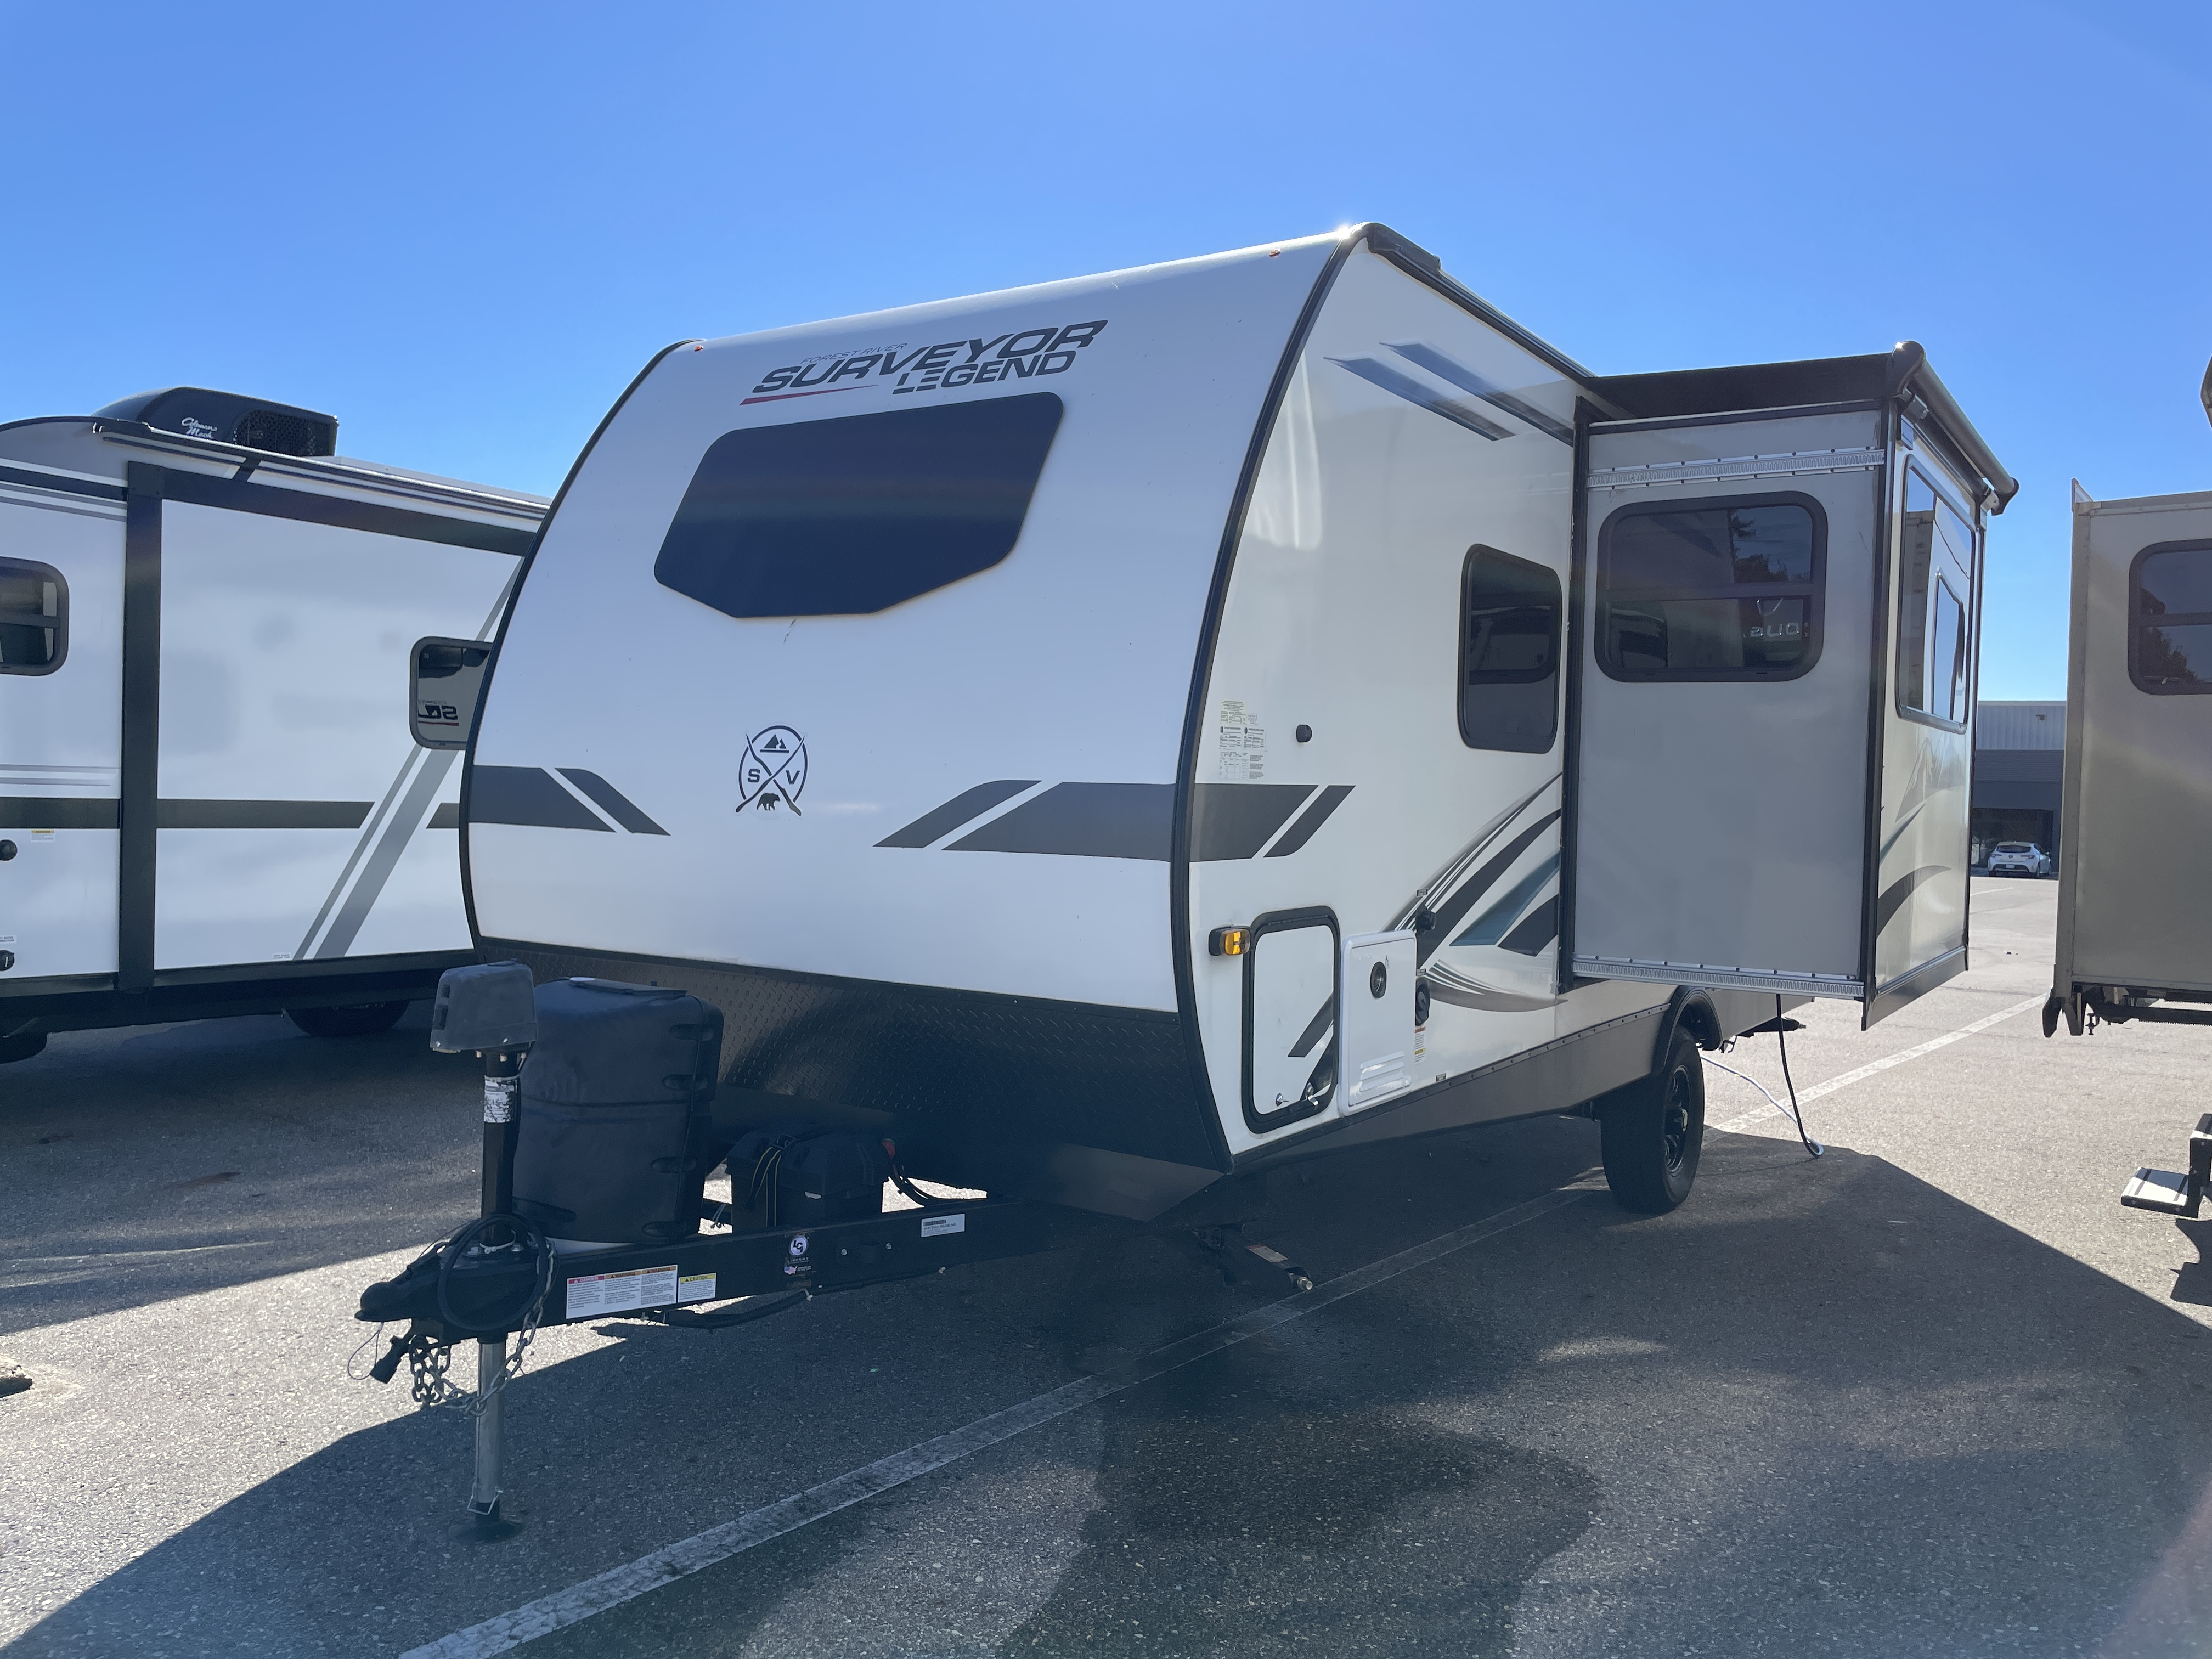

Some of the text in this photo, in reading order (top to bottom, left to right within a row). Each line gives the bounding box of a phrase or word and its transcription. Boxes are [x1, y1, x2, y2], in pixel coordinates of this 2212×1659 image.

[752, 320, 1108, 393] SURVEYOR
[800, 343, 908, 364] FOREST RIVER
[892, 350, 1077, 395] LEGEND
[747, 768, 800, 785] S V
[793, 1240, 804, 1253] LCI
